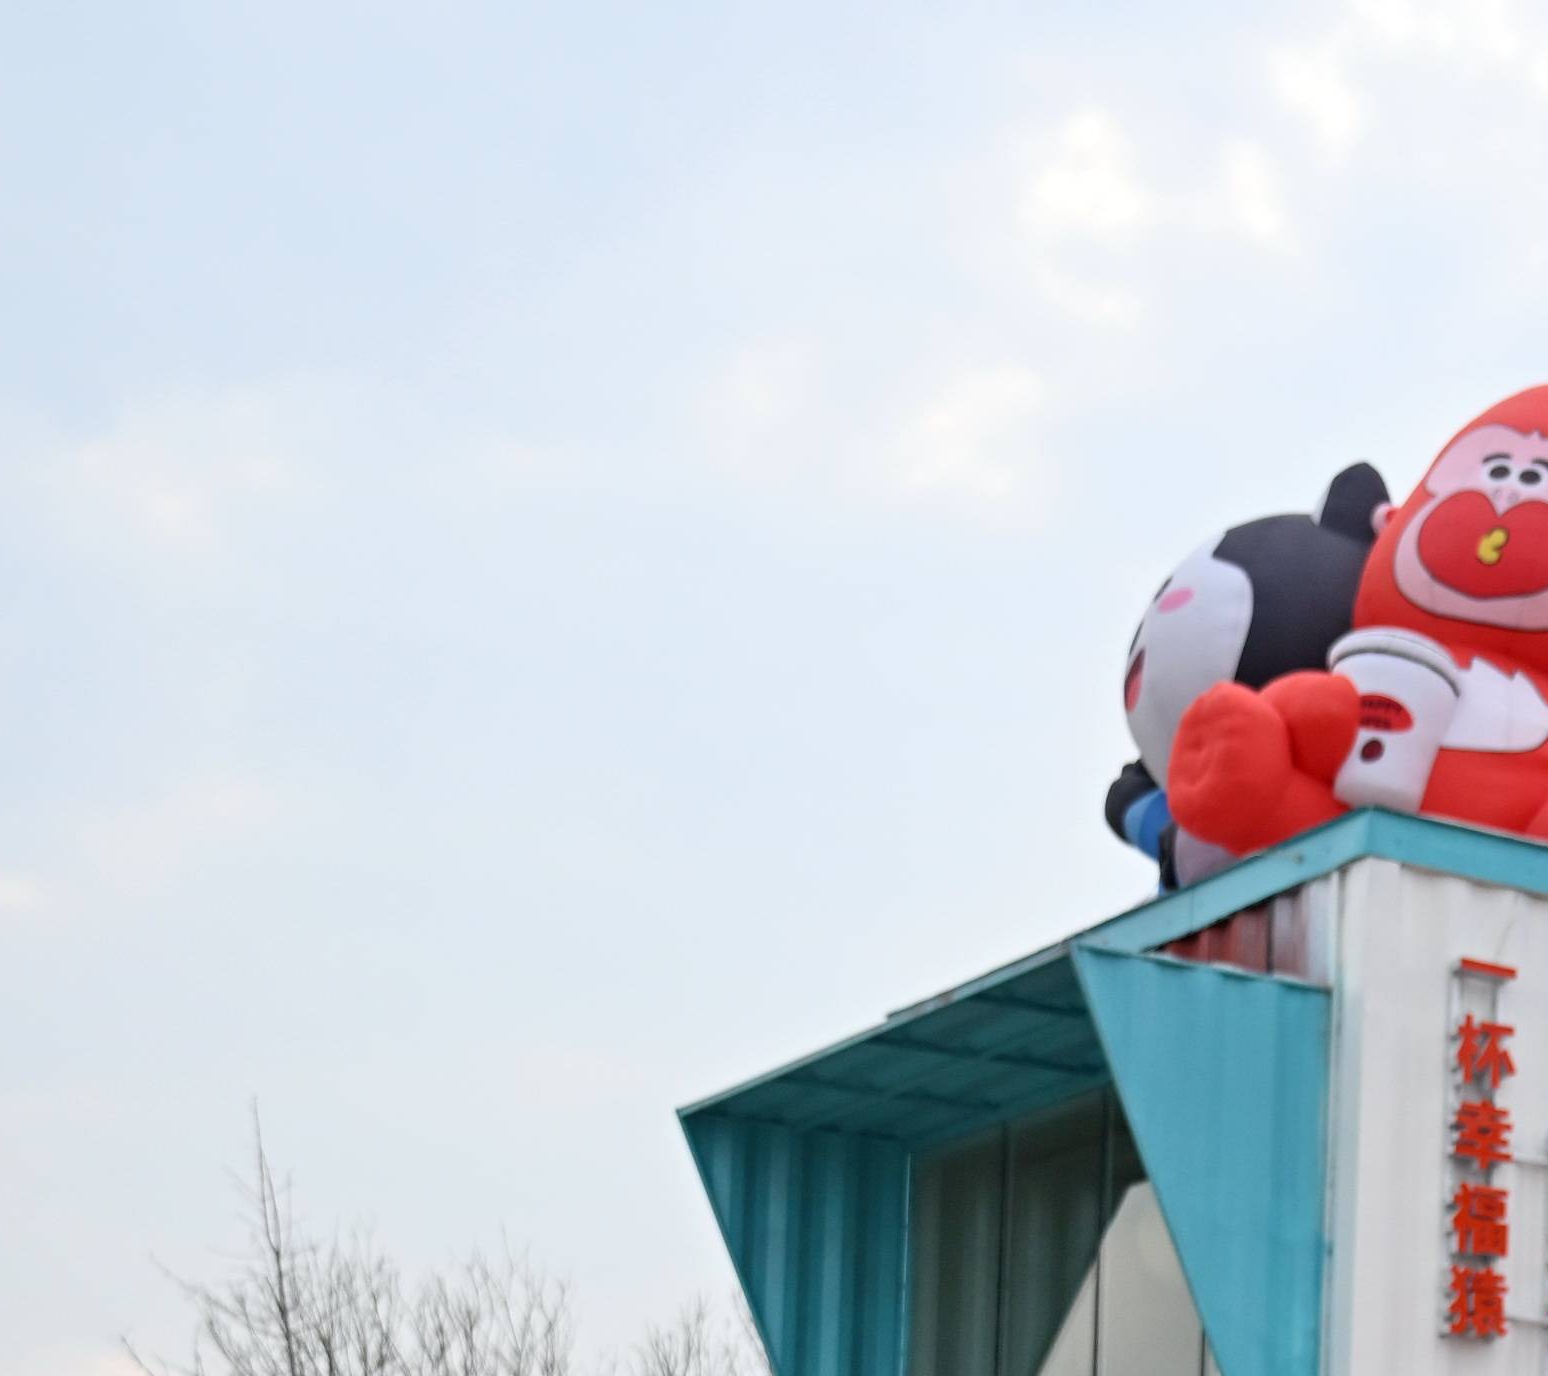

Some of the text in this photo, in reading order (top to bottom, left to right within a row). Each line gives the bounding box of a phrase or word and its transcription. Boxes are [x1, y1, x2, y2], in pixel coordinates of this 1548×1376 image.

[1448, 957, 1517, 1338] 一杯幸福猿
